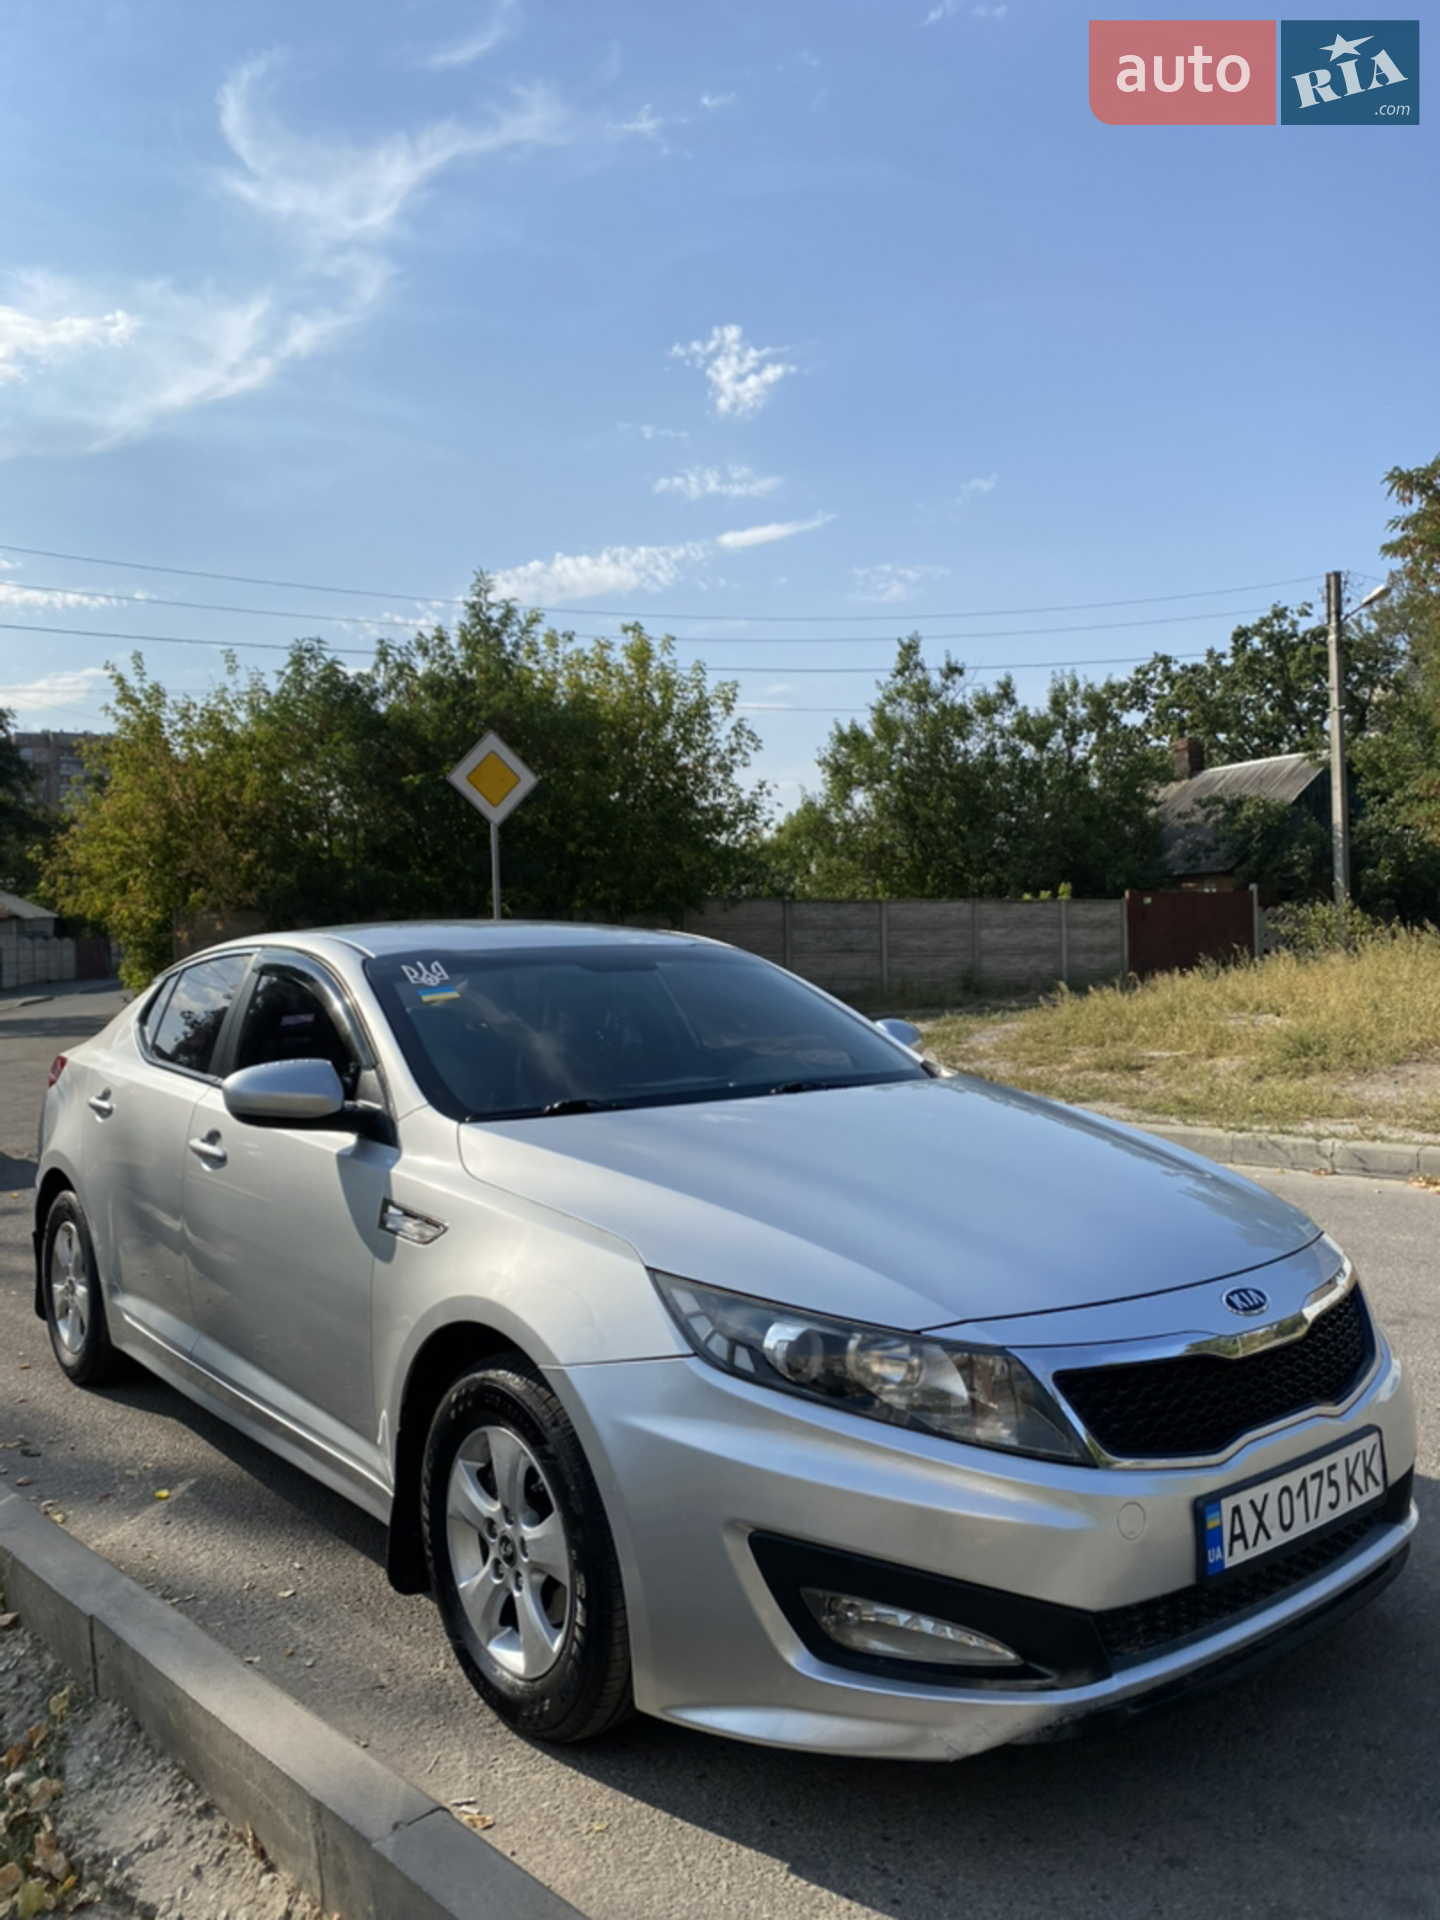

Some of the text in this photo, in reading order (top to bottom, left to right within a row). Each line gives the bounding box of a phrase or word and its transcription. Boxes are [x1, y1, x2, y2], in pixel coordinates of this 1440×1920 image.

[1228, 1290, 1265, 1310] KIA
[1228, 1443, 1380, 1557] AX 0175 KK
[1207, 1547, 1222, 1563] UA
